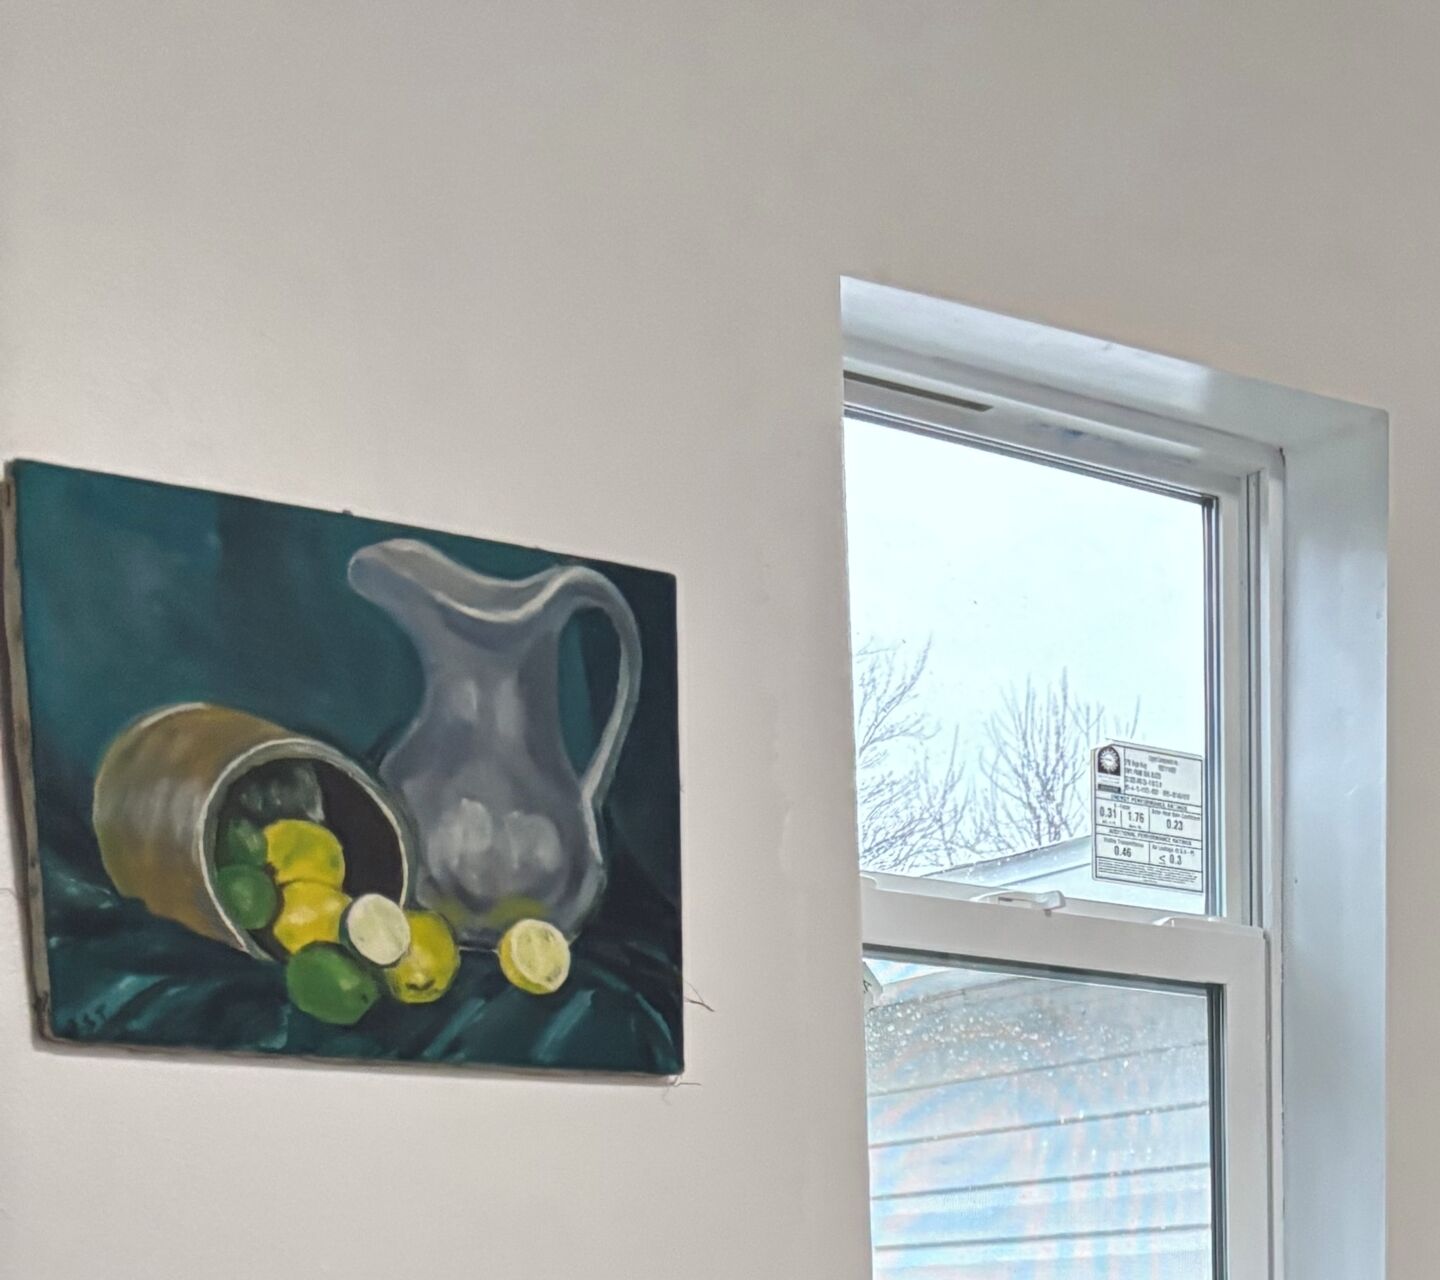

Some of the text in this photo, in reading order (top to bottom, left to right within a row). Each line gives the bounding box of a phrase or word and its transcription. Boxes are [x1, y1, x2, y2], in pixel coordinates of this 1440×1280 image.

[1099, 806, 1117, 819] 0.31
[1166, 818, 1184, 831] 0.23
[1113, 845, 1132, 858] 0.46
[1169, 854, 1182, 866] 0.3
